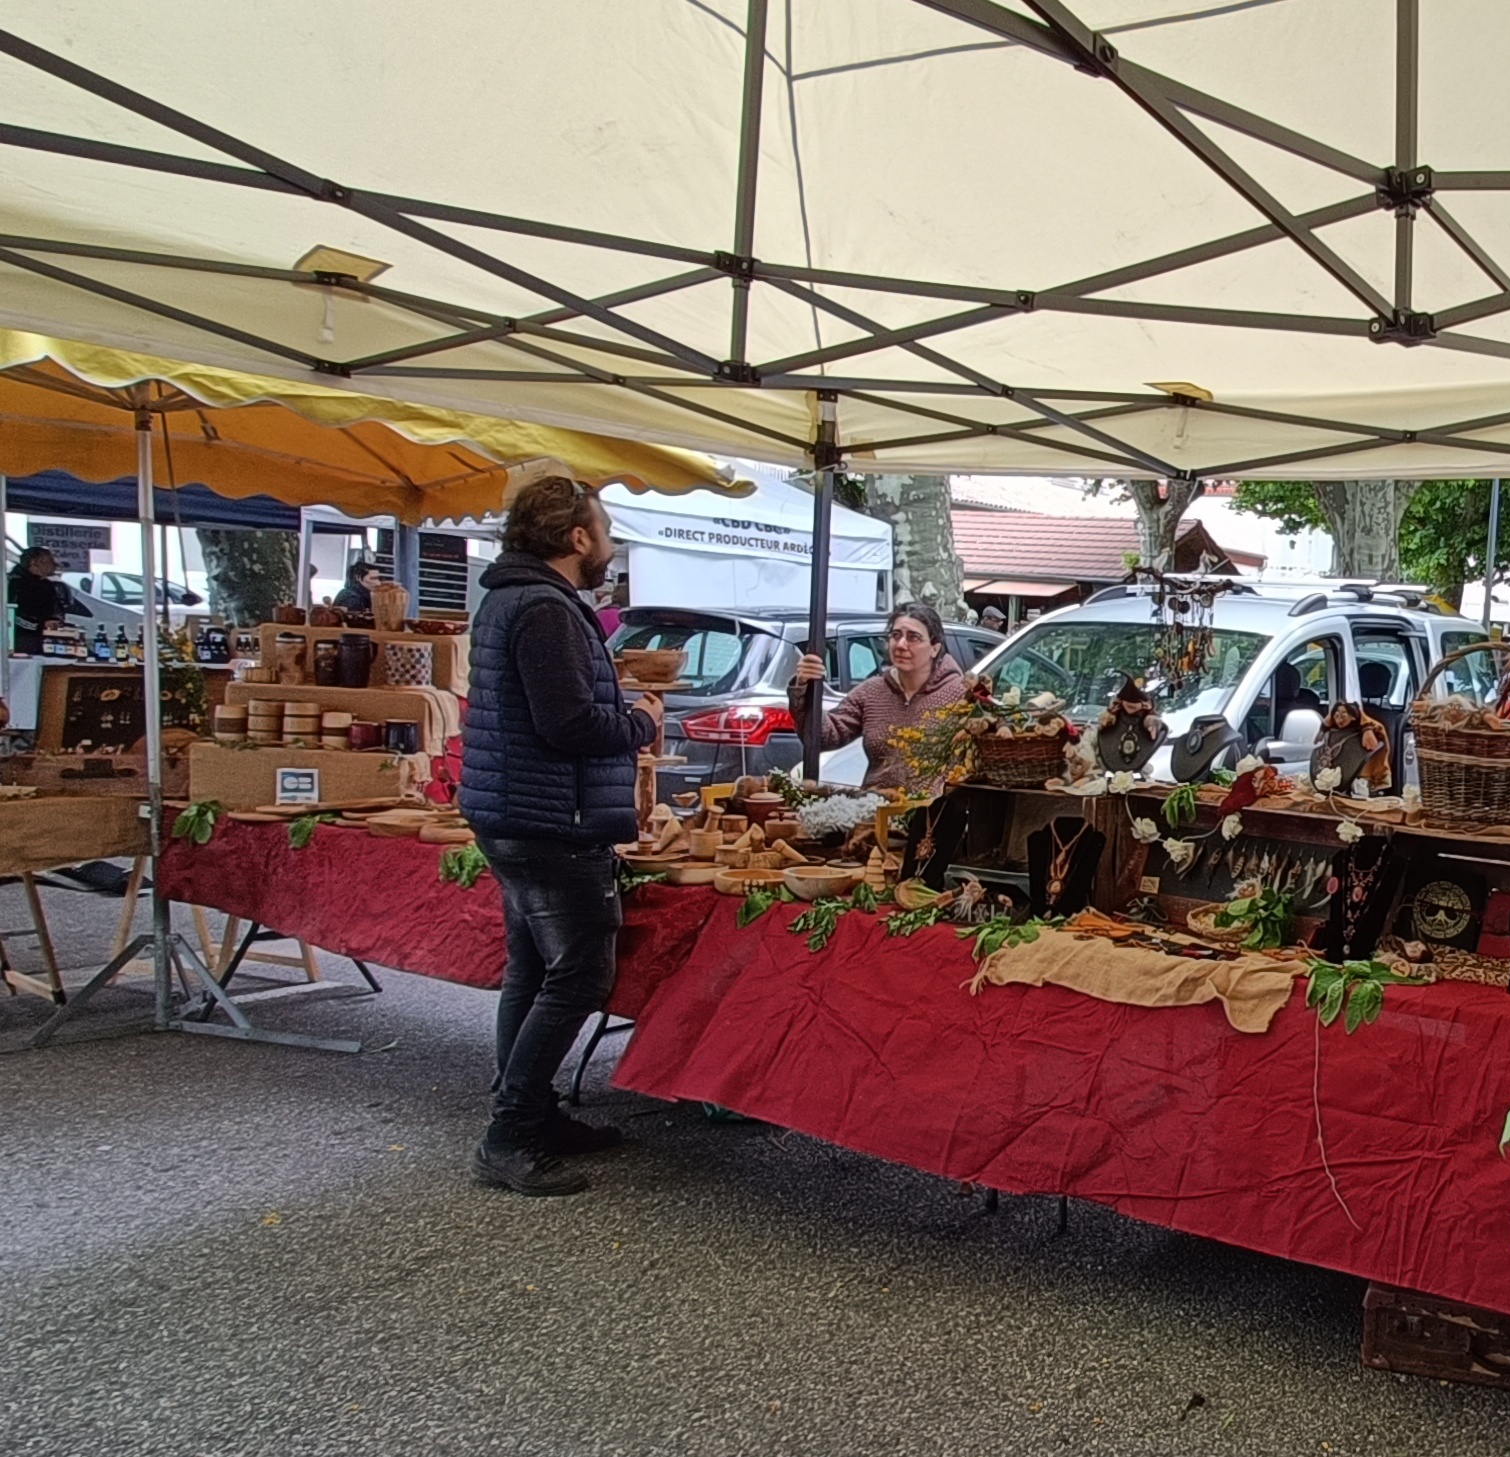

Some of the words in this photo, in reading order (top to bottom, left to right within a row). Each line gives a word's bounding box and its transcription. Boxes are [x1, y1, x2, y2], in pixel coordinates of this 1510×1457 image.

[31, 525, 103, 539] Distillerie
[658, 527, 706, 542] «DIRECT
[708, 532, 781, 551] PRODUCTEUR
